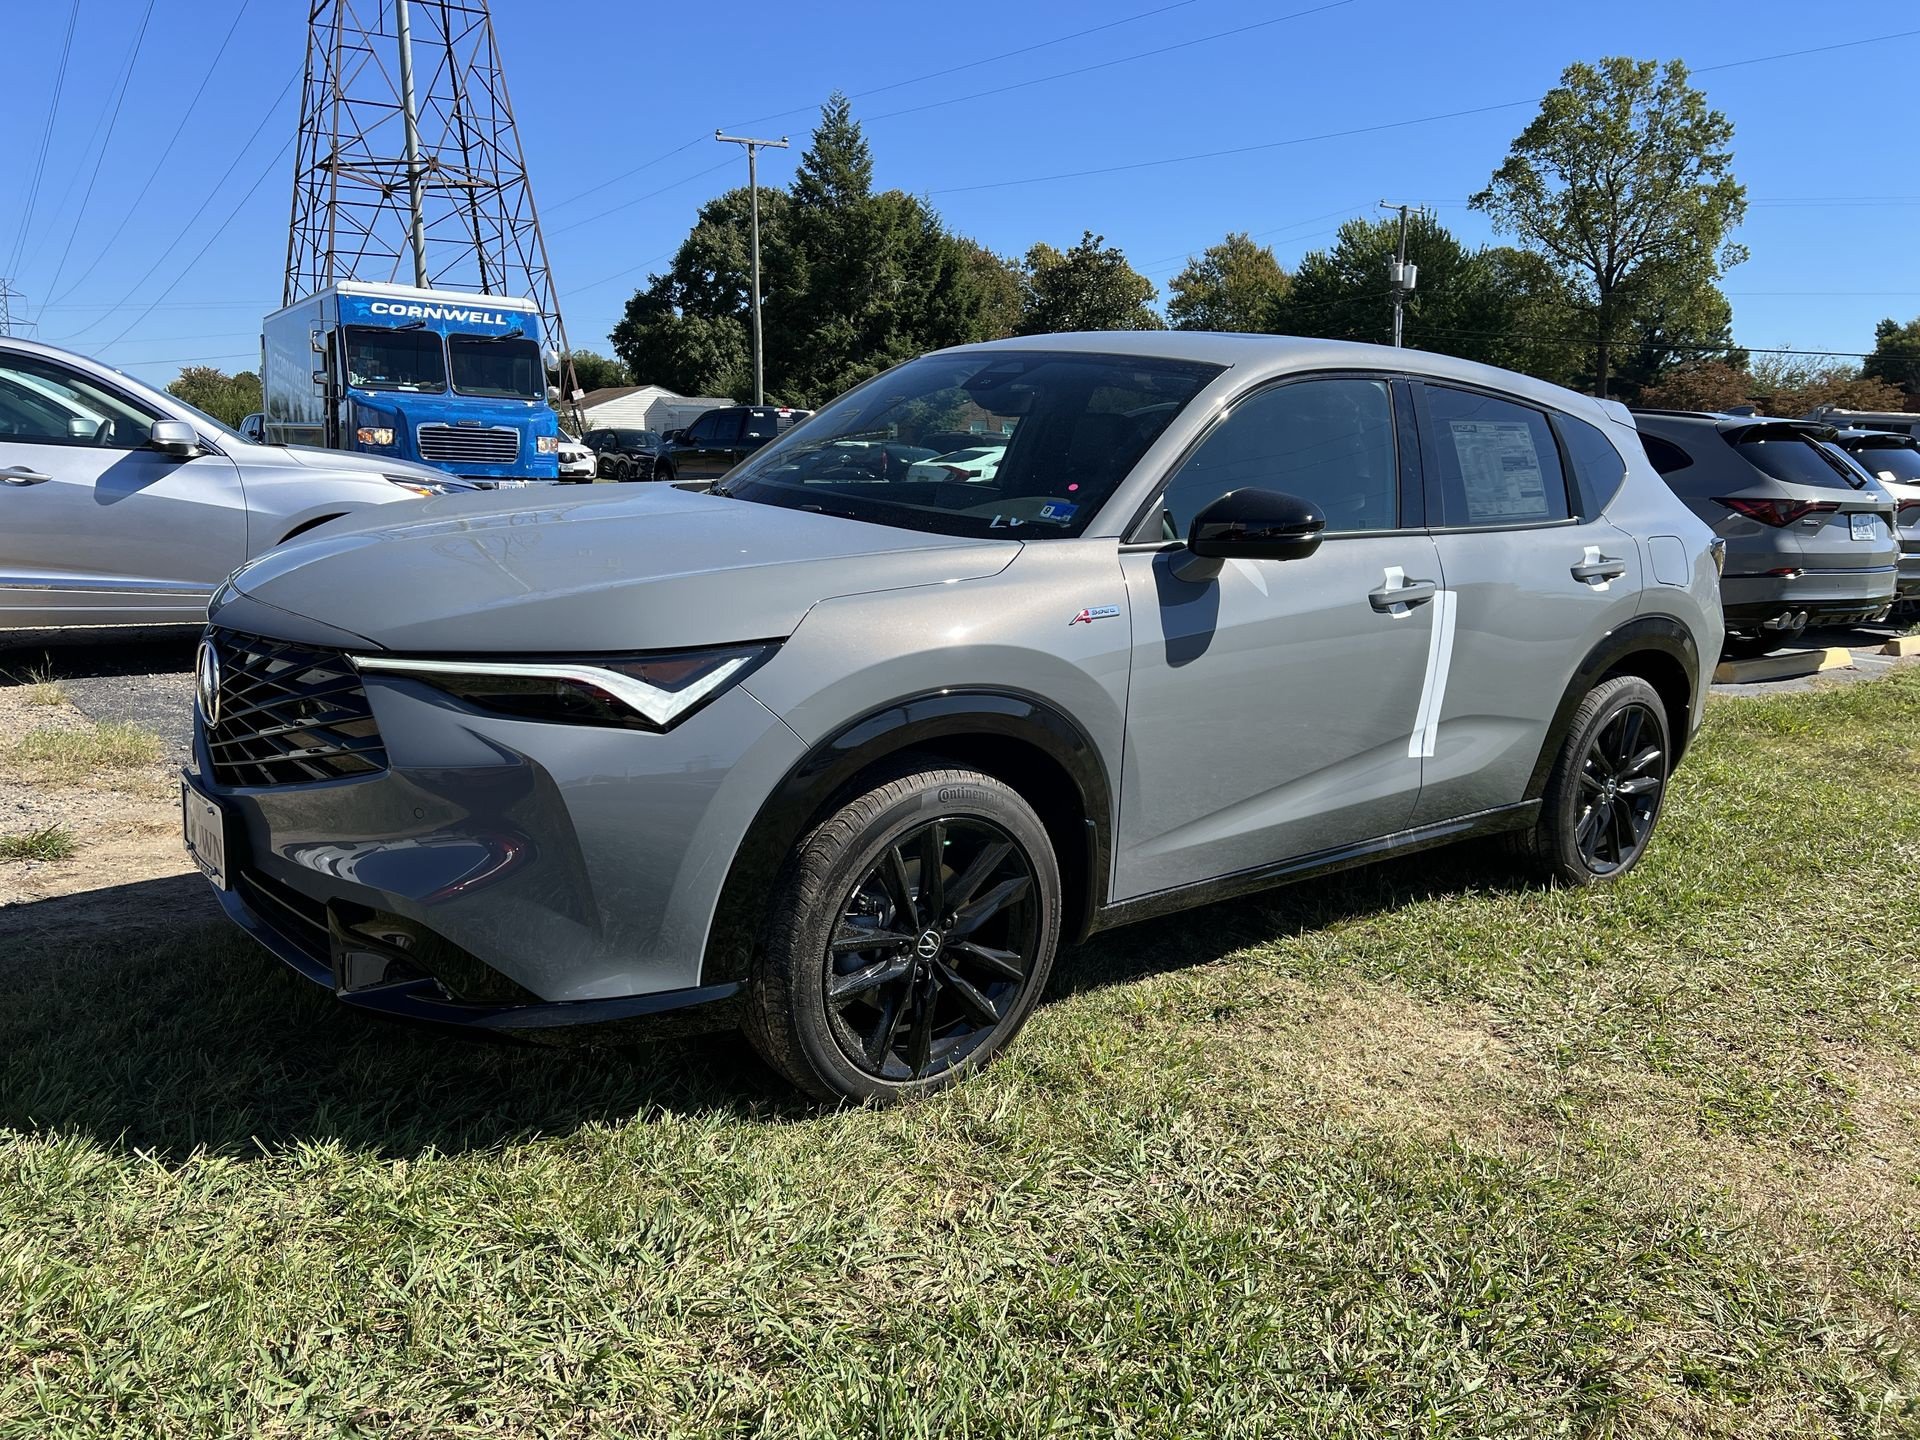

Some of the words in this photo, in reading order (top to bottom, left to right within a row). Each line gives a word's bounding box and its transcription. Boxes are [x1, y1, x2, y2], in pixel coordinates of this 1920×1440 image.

[371, 302, 507, 325] CORNWELL
[1043, 506, 1052, 515] 9
[938, 786, 998, 804] Continental
